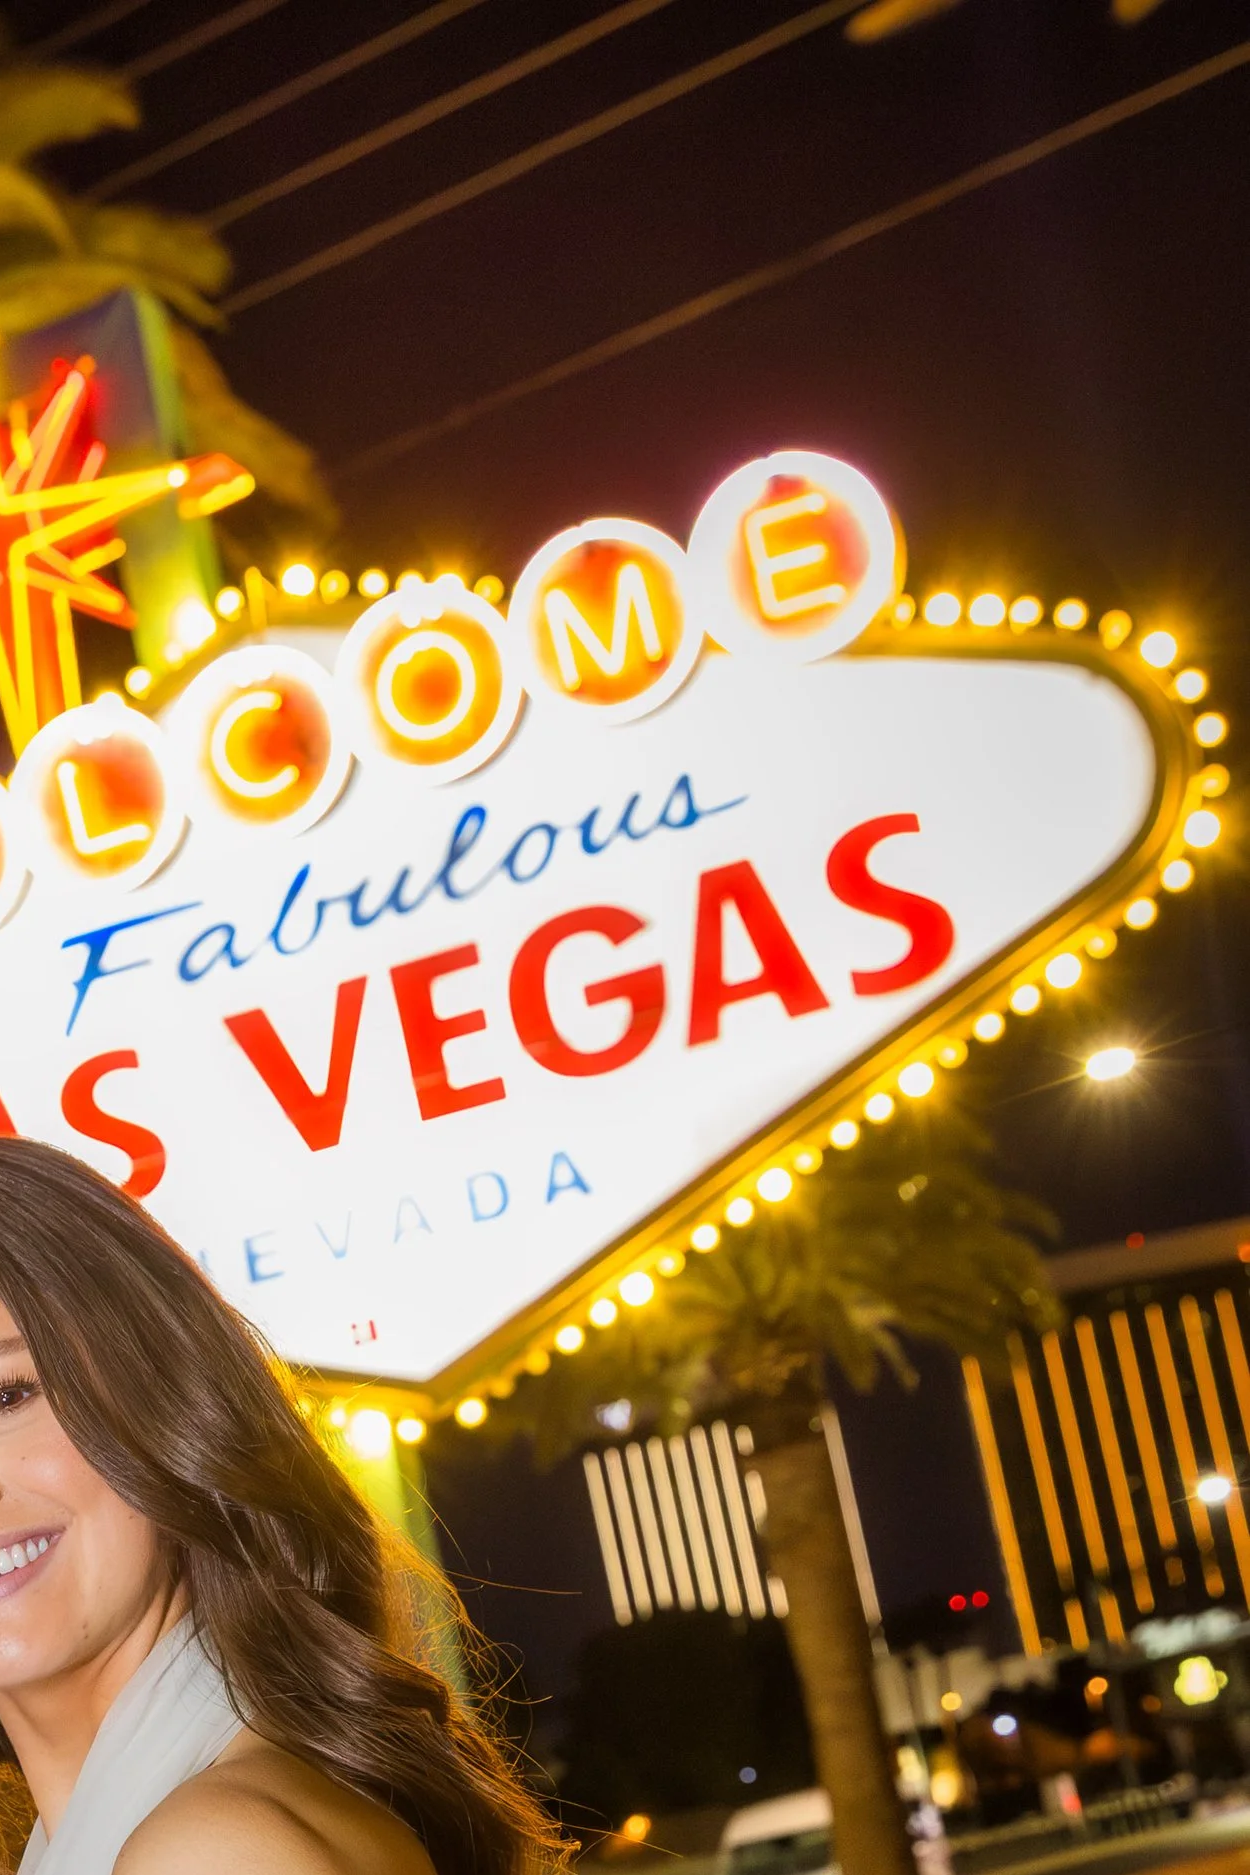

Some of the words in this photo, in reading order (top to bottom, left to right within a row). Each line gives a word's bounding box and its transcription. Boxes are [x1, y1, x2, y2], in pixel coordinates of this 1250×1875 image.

[60, 773, 747, 1036] Fabulous
[223, 812, 956, 1153] VEGAS
[196, 1148, 595, 1287] EVADA
